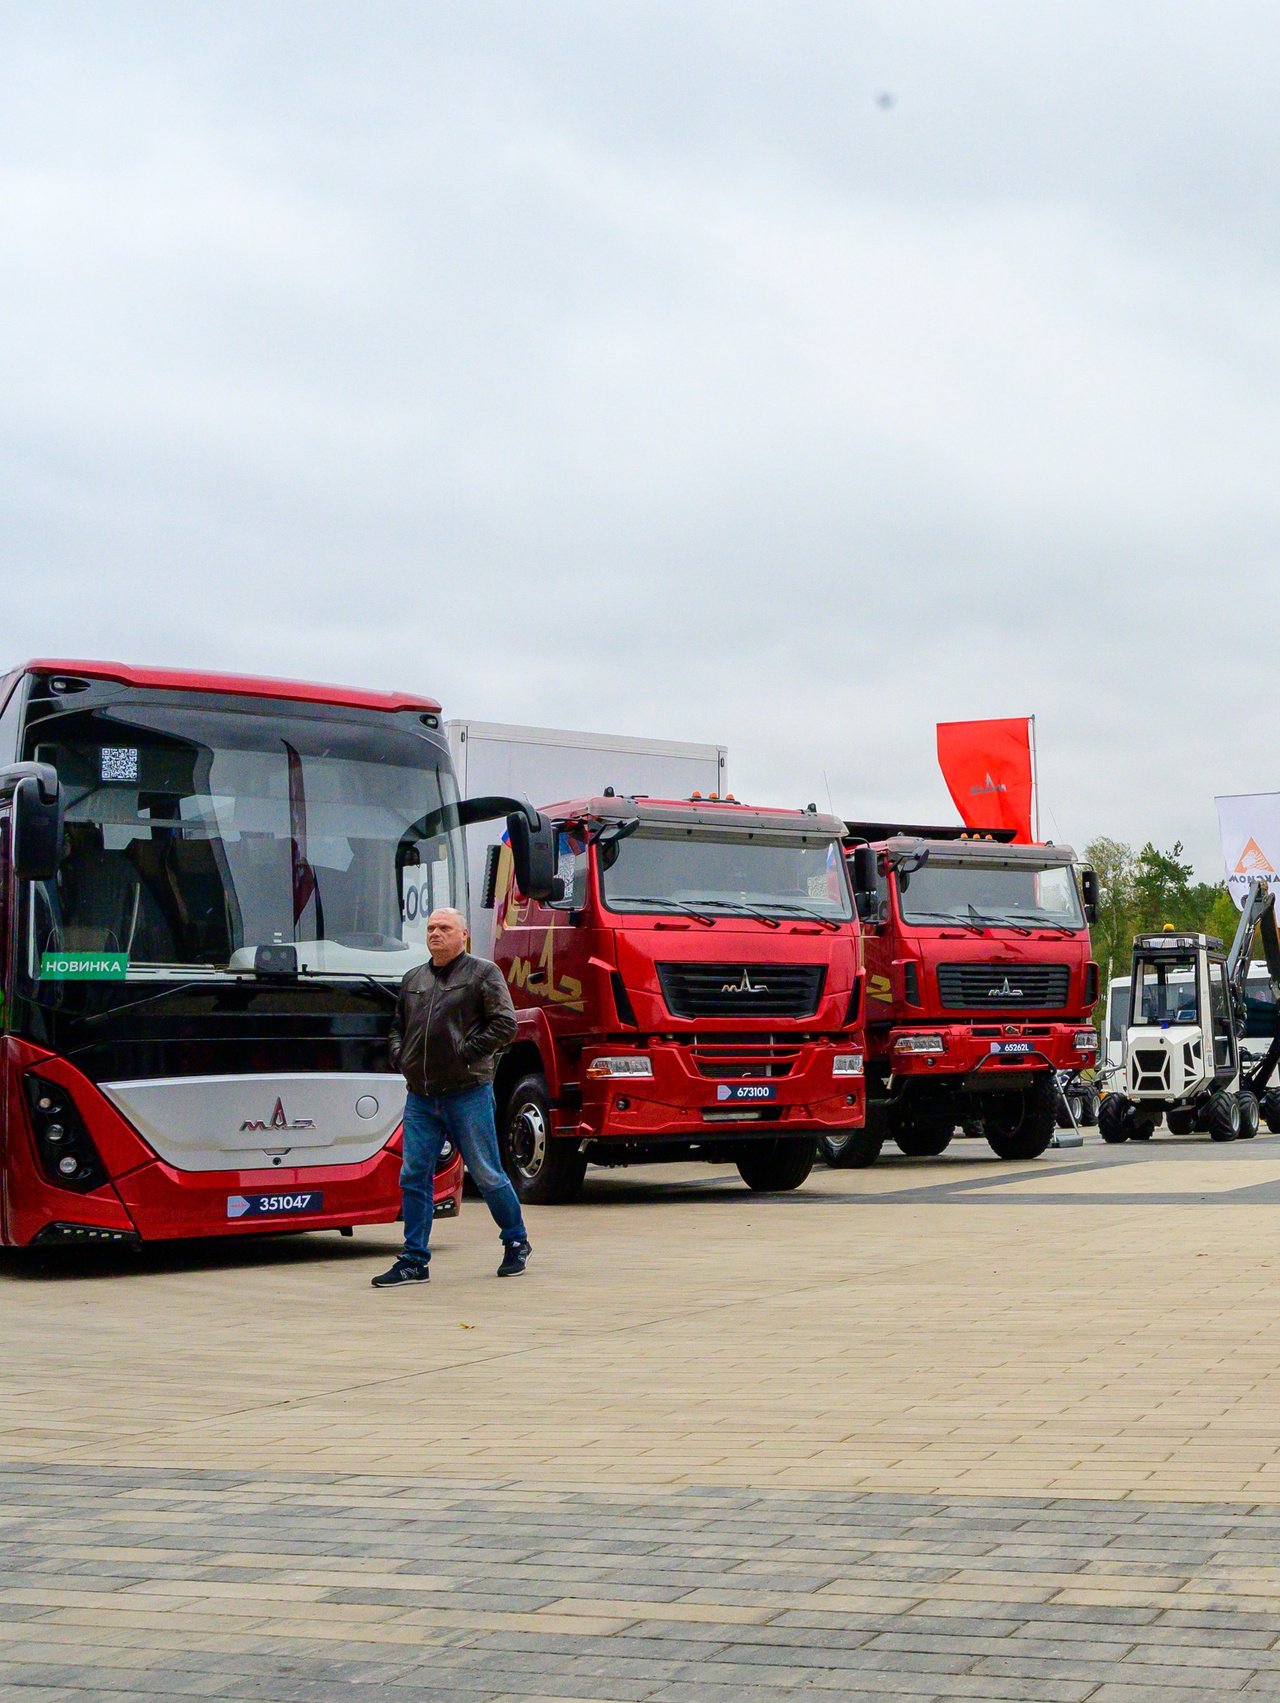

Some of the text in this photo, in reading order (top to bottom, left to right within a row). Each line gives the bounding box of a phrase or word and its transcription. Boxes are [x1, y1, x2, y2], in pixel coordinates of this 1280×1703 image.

[46, 961, 121, 973] НОВИНКА
[1004, 1043, 1029, 1052] 65262L
[736, 1086, 770, 1097] 673100
[259, 1194, 312, 1211] 351047
